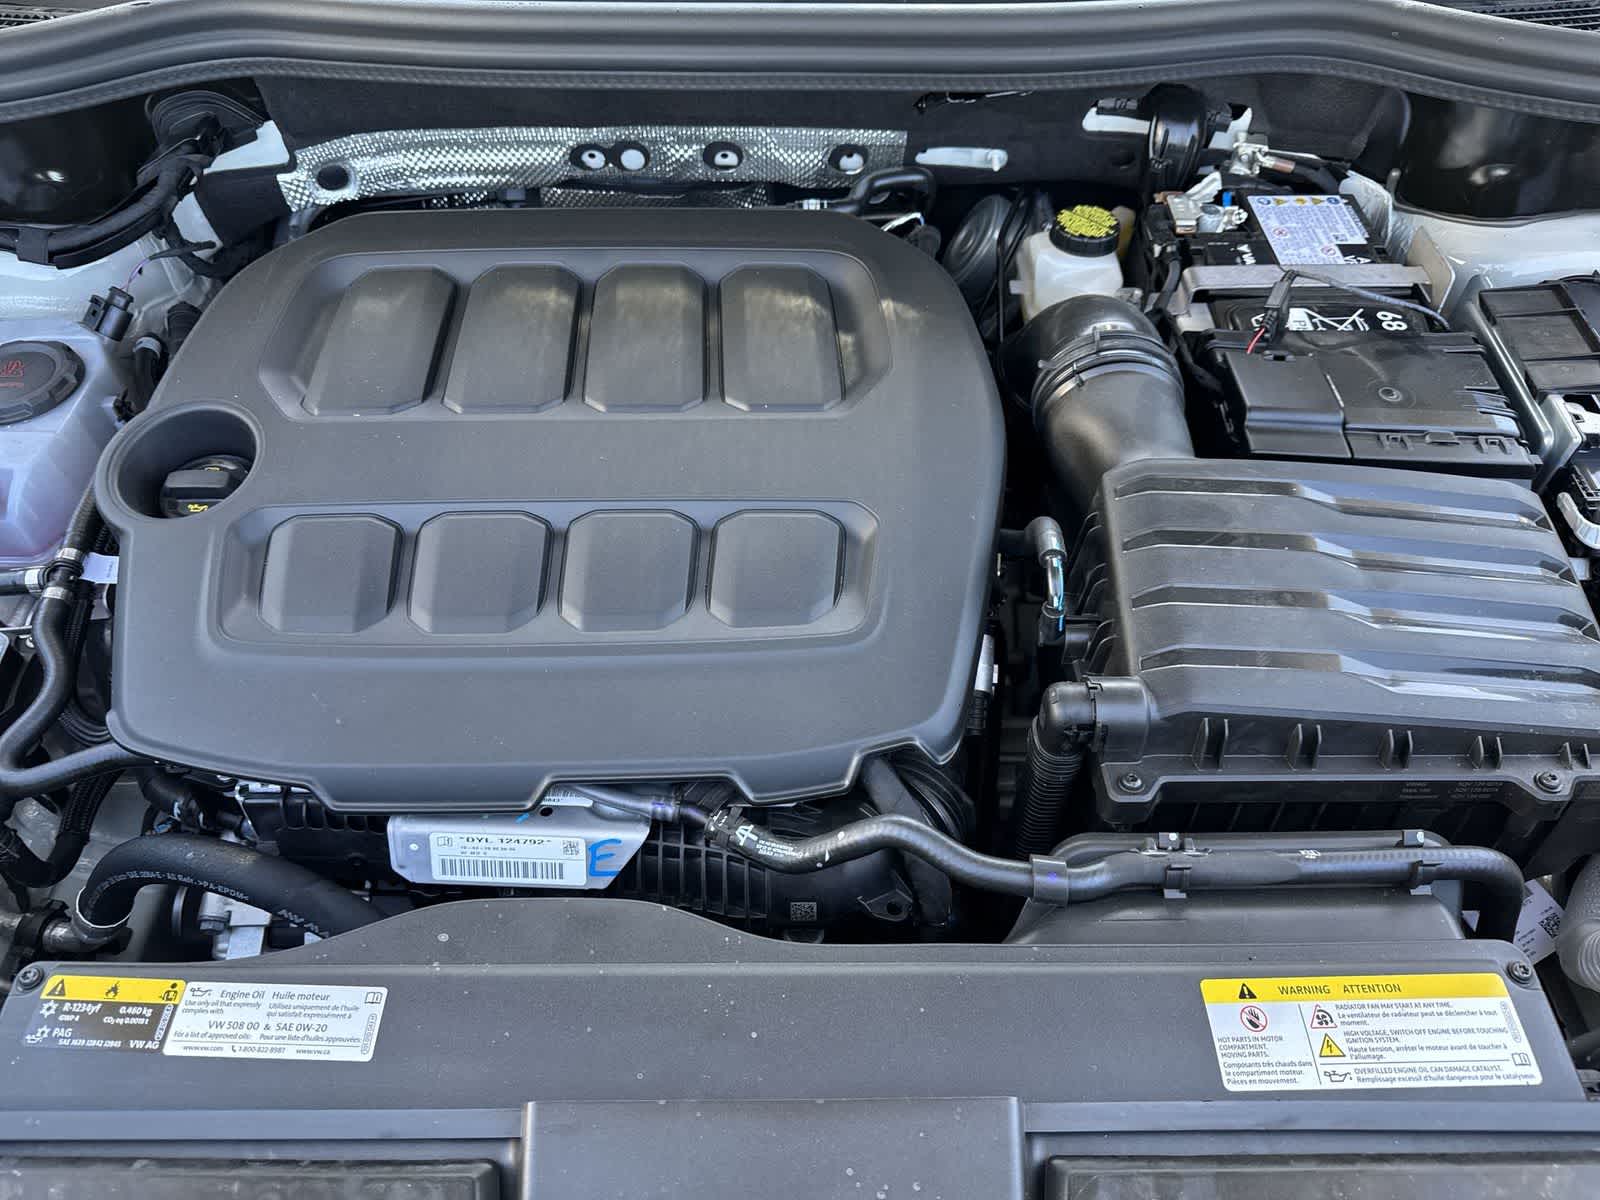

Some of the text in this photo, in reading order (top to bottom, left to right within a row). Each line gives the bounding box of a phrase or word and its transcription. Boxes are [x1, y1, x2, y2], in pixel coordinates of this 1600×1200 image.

[1278, 984, 1402, 994] WARNING ATTENTION
[220, 990, 250, 1000] Engine
[252, 990, 265, 999] Oil
[272, 991, 296, 1000] Huile
[208, 1020, 225, 1030] VW
[226, 1021, 245, 1030] 508
[246, 1022, 260, 1030] 00
[275, 1023, 294, 1031] SAE
[52, 1027, 73, 1038] PAG
[129, 1040, 160, 1050] VW AG
